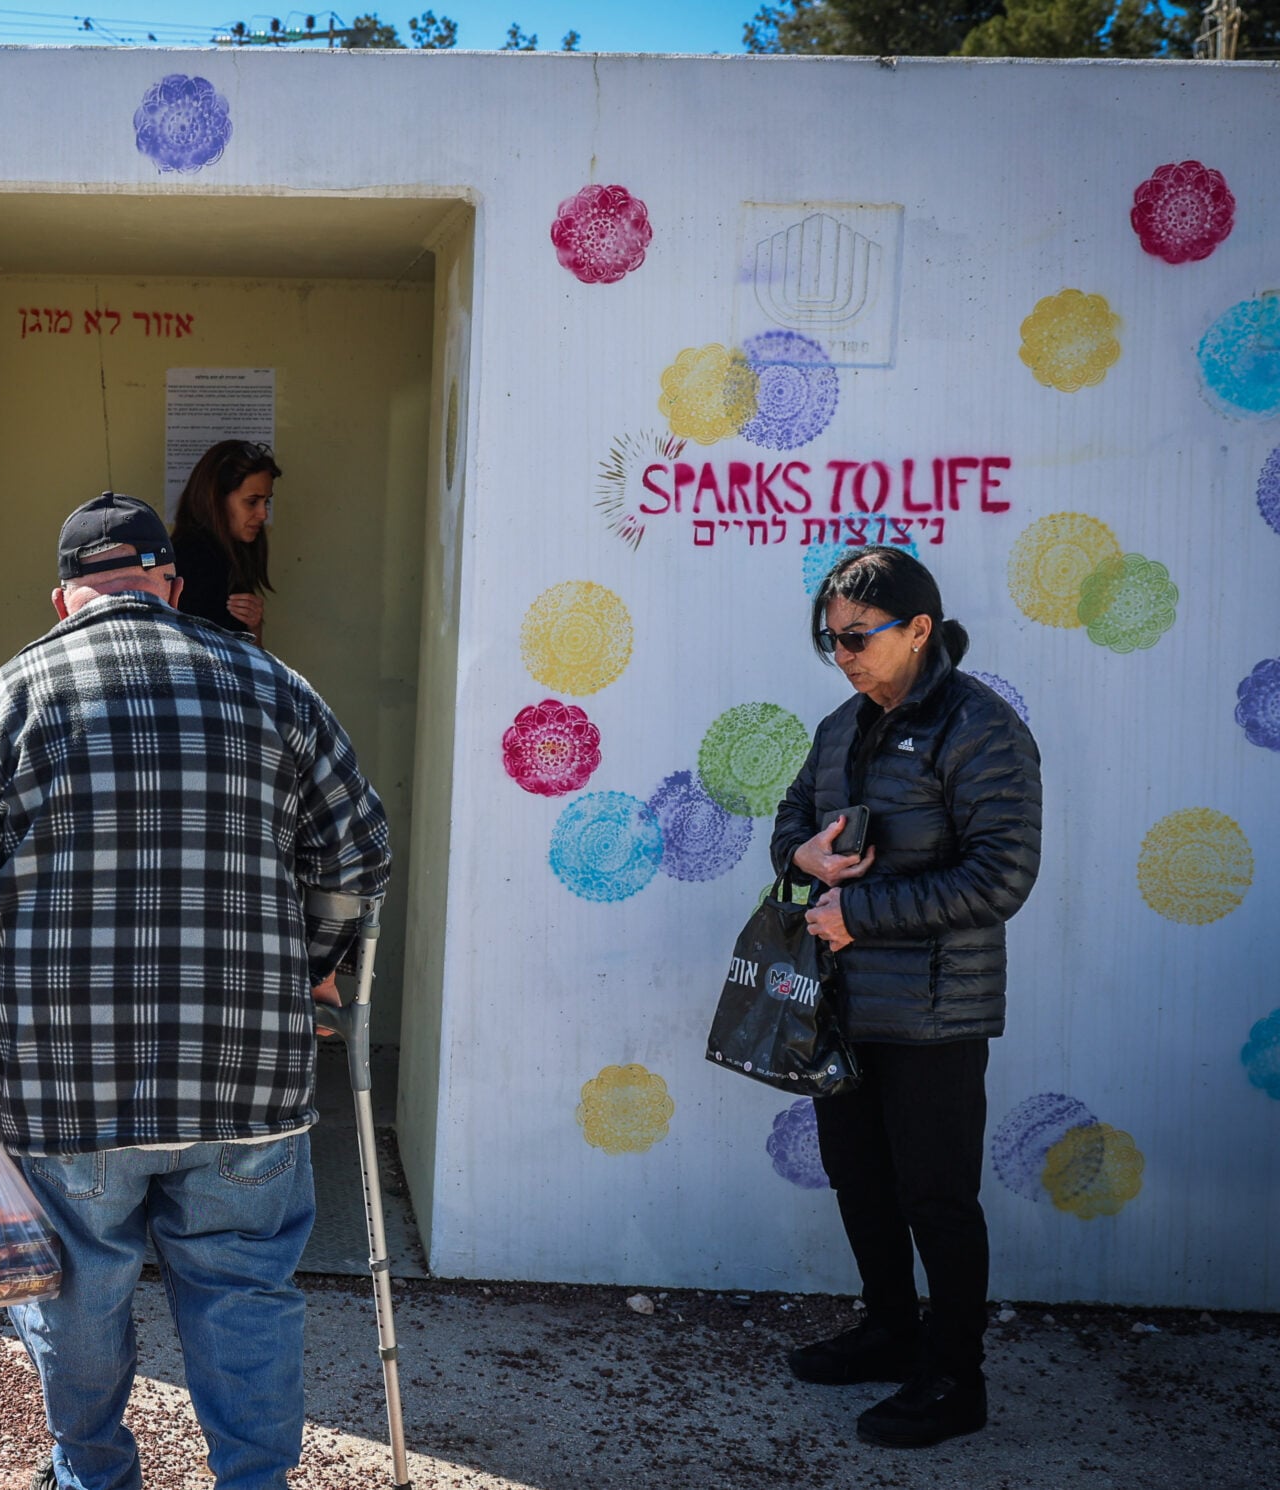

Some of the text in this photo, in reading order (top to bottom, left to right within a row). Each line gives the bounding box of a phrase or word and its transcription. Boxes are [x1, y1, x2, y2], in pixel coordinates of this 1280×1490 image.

[18, 303, 195, 339] אזור לא מוגן
[639, 456, 1012, 514] SPARKS TO LIFE
[693, 513, 945, 546] ניצוצות לחיים
